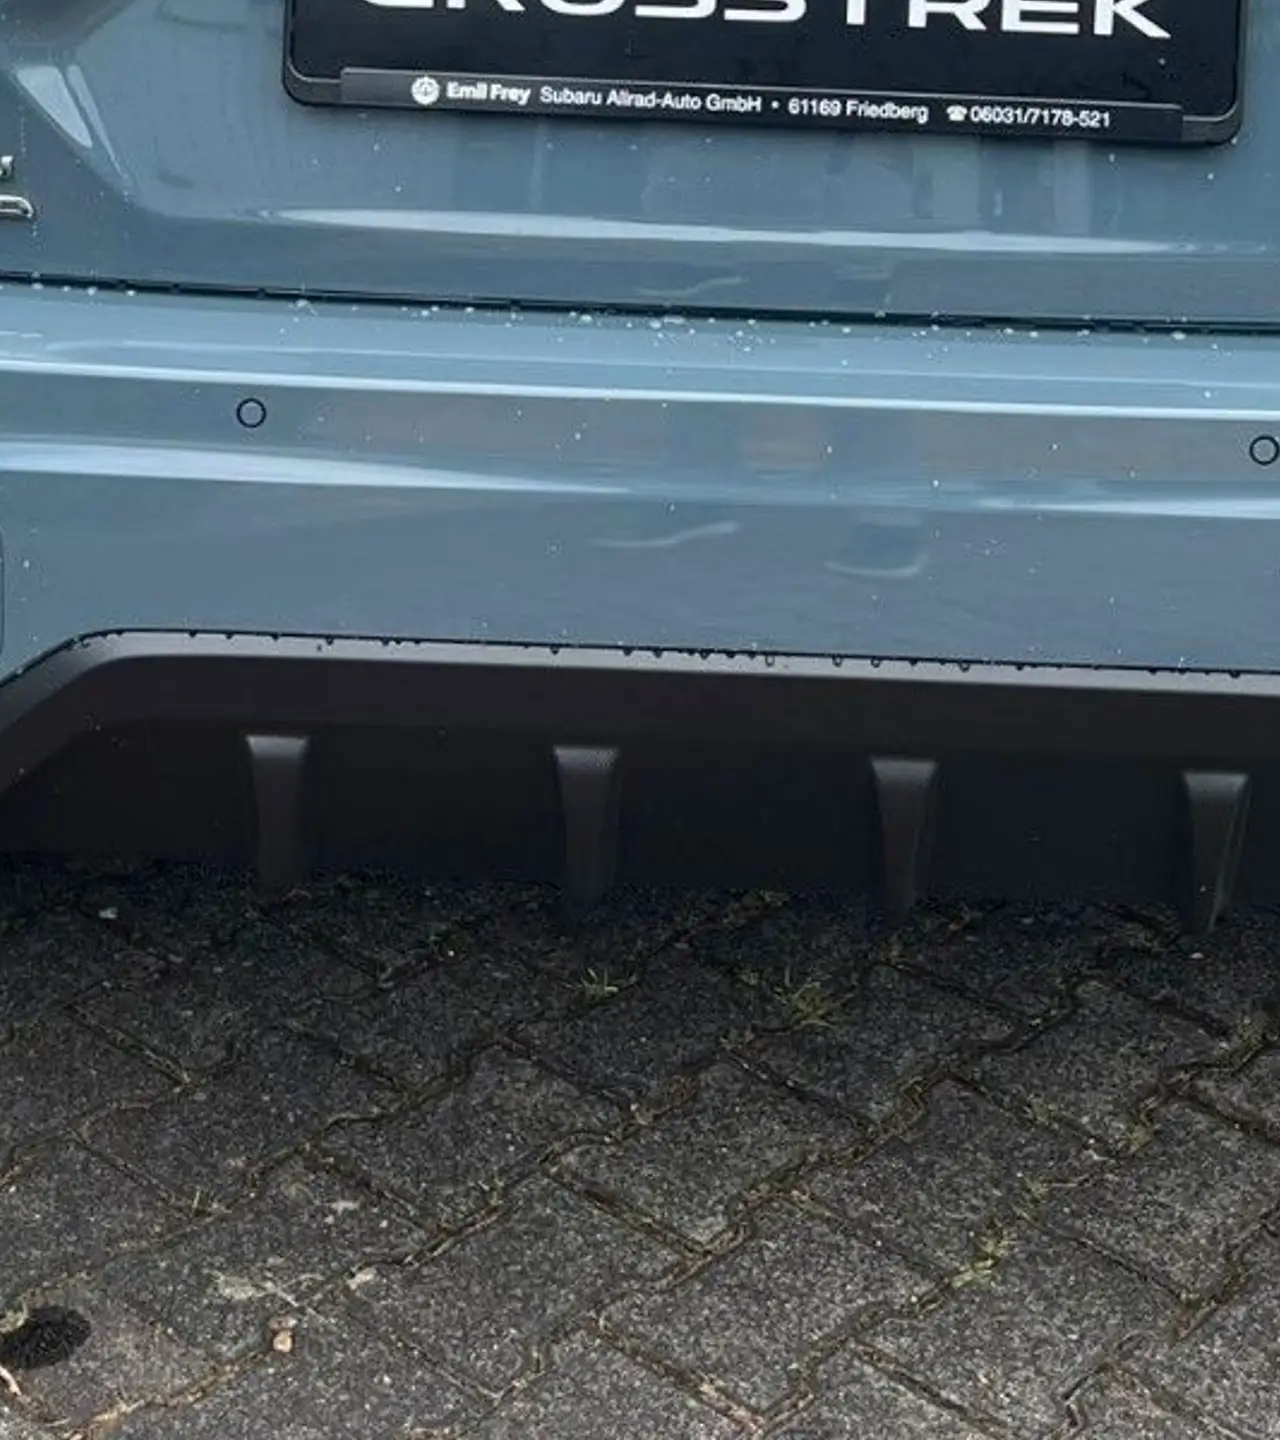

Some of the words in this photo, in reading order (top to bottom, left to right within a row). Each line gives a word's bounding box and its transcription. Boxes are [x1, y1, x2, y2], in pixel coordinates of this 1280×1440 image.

[446, 81, 487, 100] Emil
[489, 83, 532, 106] Frey
[539, 85, 603, 107] Subaru
[606, 89, 703, 111] Allrad-Auto
[705, 92, 762, 113] GmbH
[788, 99, 842, 117] 61169
[845, 101, 930, 125] Friedberg
[969, 107, 1111, 128] 06031/7178-521
